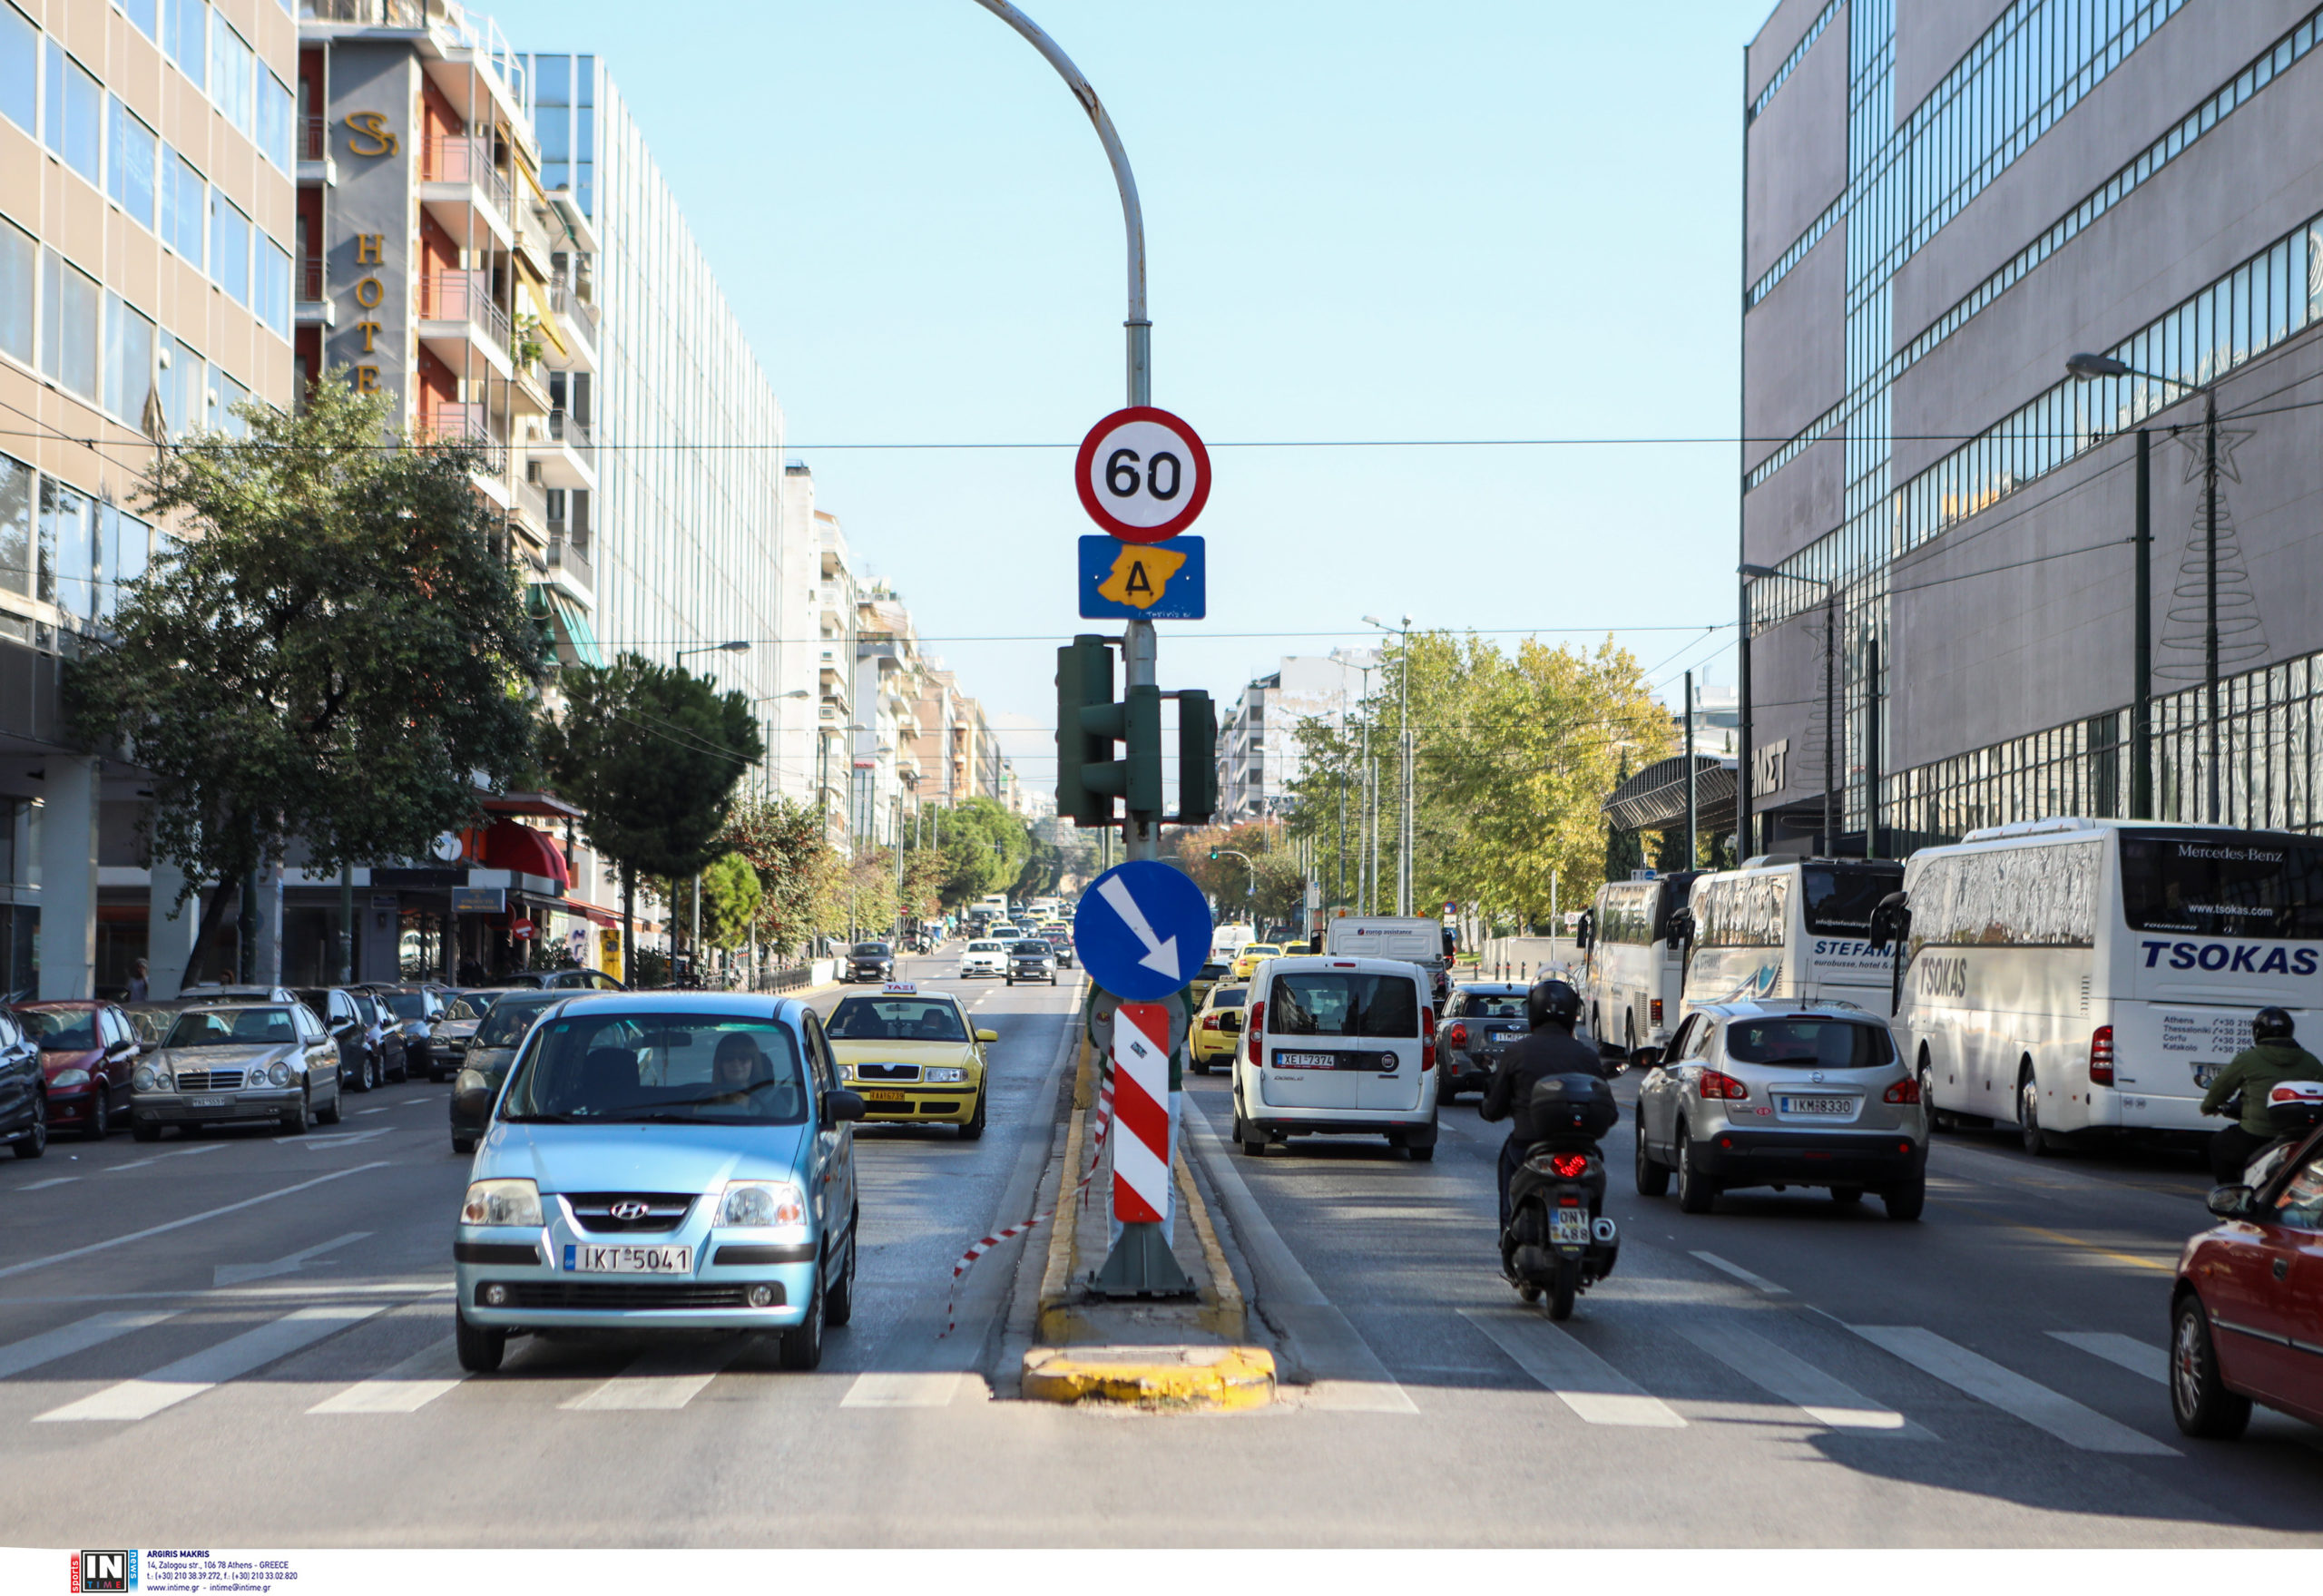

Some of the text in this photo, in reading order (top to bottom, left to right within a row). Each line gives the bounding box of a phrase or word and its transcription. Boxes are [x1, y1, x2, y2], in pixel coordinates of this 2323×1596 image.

[355, 233, 386, 395] HOTE
[1105, 447, 1182, 502] 60
[2178, 844, 2284, 863] Mercedes-Benz
[2188, 904, 2273, 917] www.tsokas.com
[2142, 940, 2319, 976] TSOKAS
[1920, 957, 1967, 998] TSOKAS
[2164, 1016, 2194, 1024] Athens
[2164, 1025, 2211, 1034] Thessaloniki
[2163, 1043, 2197, 1052] Katakolo
[1562, 1228, 1588, 1240] 488
